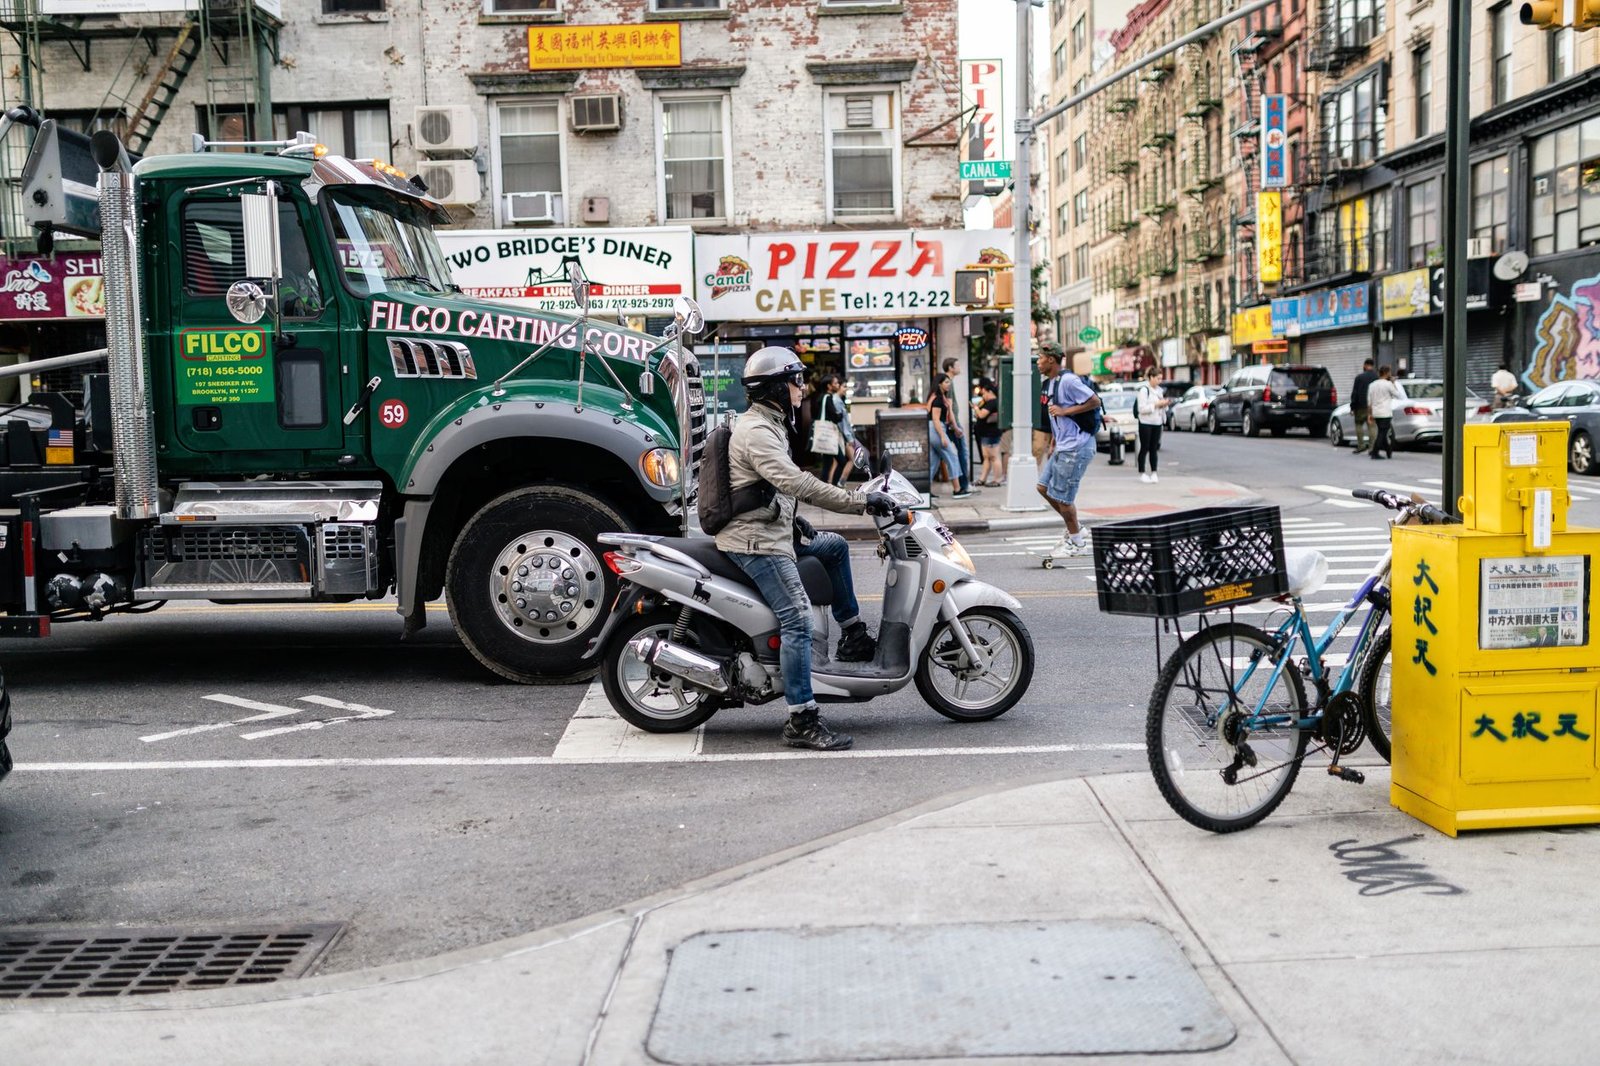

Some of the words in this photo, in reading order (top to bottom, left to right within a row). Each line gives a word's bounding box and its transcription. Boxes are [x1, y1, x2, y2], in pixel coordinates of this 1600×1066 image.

[962, 163, 998, 178] CANAL
[1000, 162, 1009, 170] ST
[445, 246, 490, 273] TWO
[497, 236, 596, 259] BRIDGE'S
[603, 238, 672, 270] DINER
[767, 241, 944, 280] PIZZA
[704, 271, 751, 286] Canal
[463, 288, 527, 297] REAKFAST
[543, 286, 579, 297] LUNC
[602, 285, 650, 295] DINNER
[728, 285, 751, 293] PIZZA
[756, 288, 836, 312] CAFE
[841, 292, 877, 309] Tel:
[371, 300, 451, 334] FILCO
[458, 310, 577, 349] CARTING
[585, 328, 657, 362] CORP
[899, 333, 927, 345] OPEN
[186, 332, 260, 353] FILCO
[187, 367, 212, 377] (718)
[215, 366, 263, 375] 456-5000
[383, 405, 405, 423] 59
[1413, 558, 1439, 677] 大紀元
[1488, 613, 1559, 626] 中方大買美國大豆
[1471, 712, 1590, 742] 大紀元
